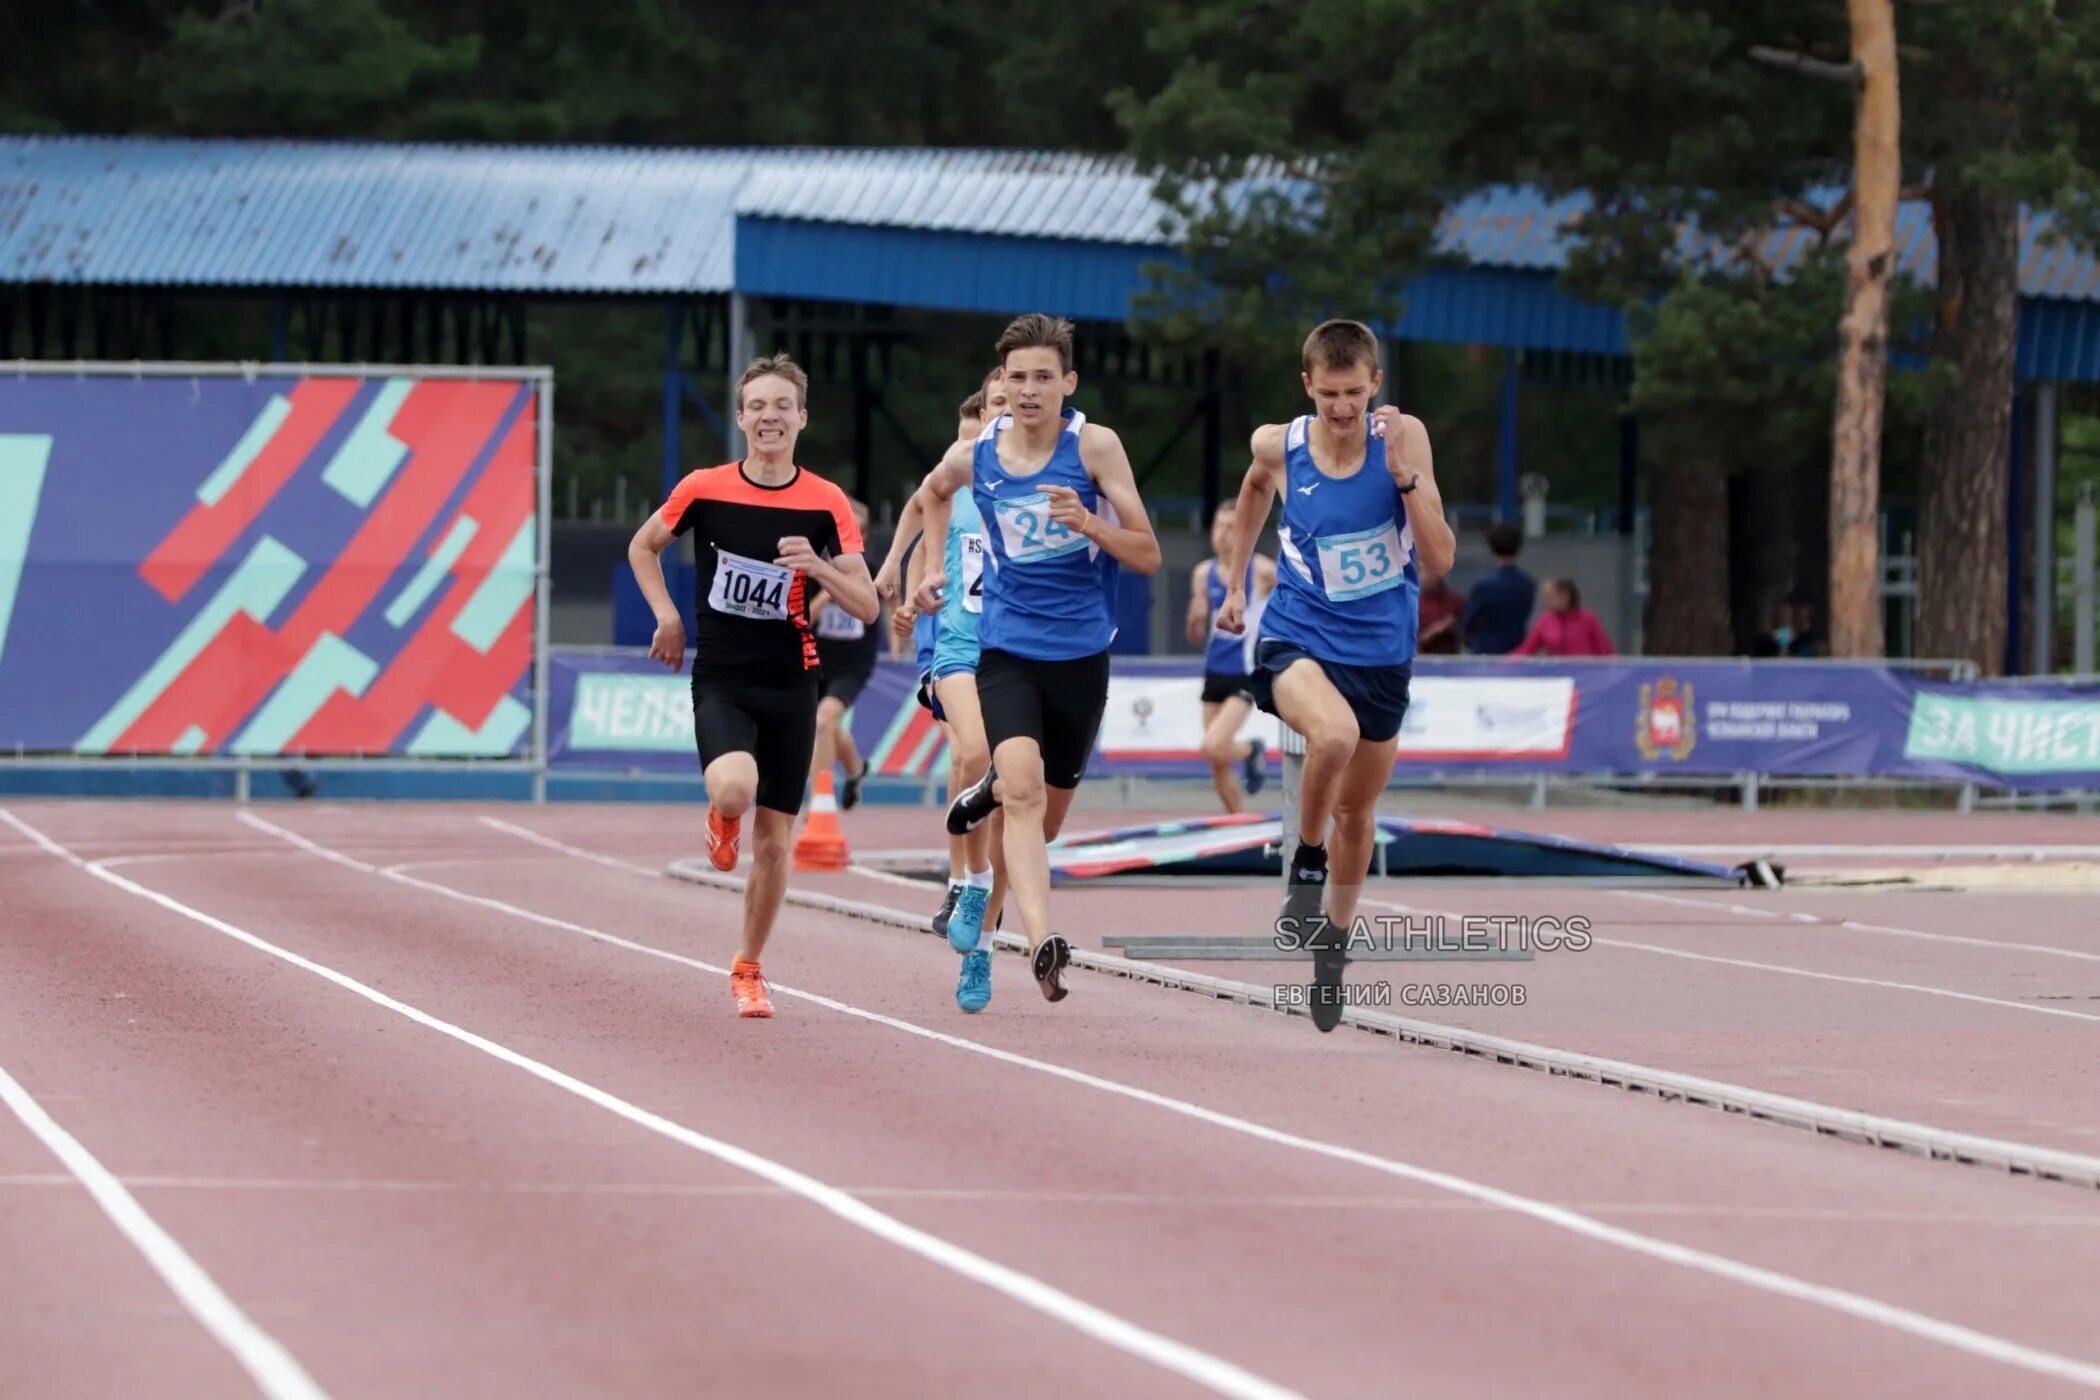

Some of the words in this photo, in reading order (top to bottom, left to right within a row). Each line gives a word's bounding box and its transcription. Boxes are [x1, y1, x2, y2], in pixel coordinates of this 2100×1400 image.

[1015, 511, 1070, 548] 24
[1339, 542, 1391, 585] 53
[723, 569, 784, 610] 1044
[1922, 704, 1978, 755] ЗА
